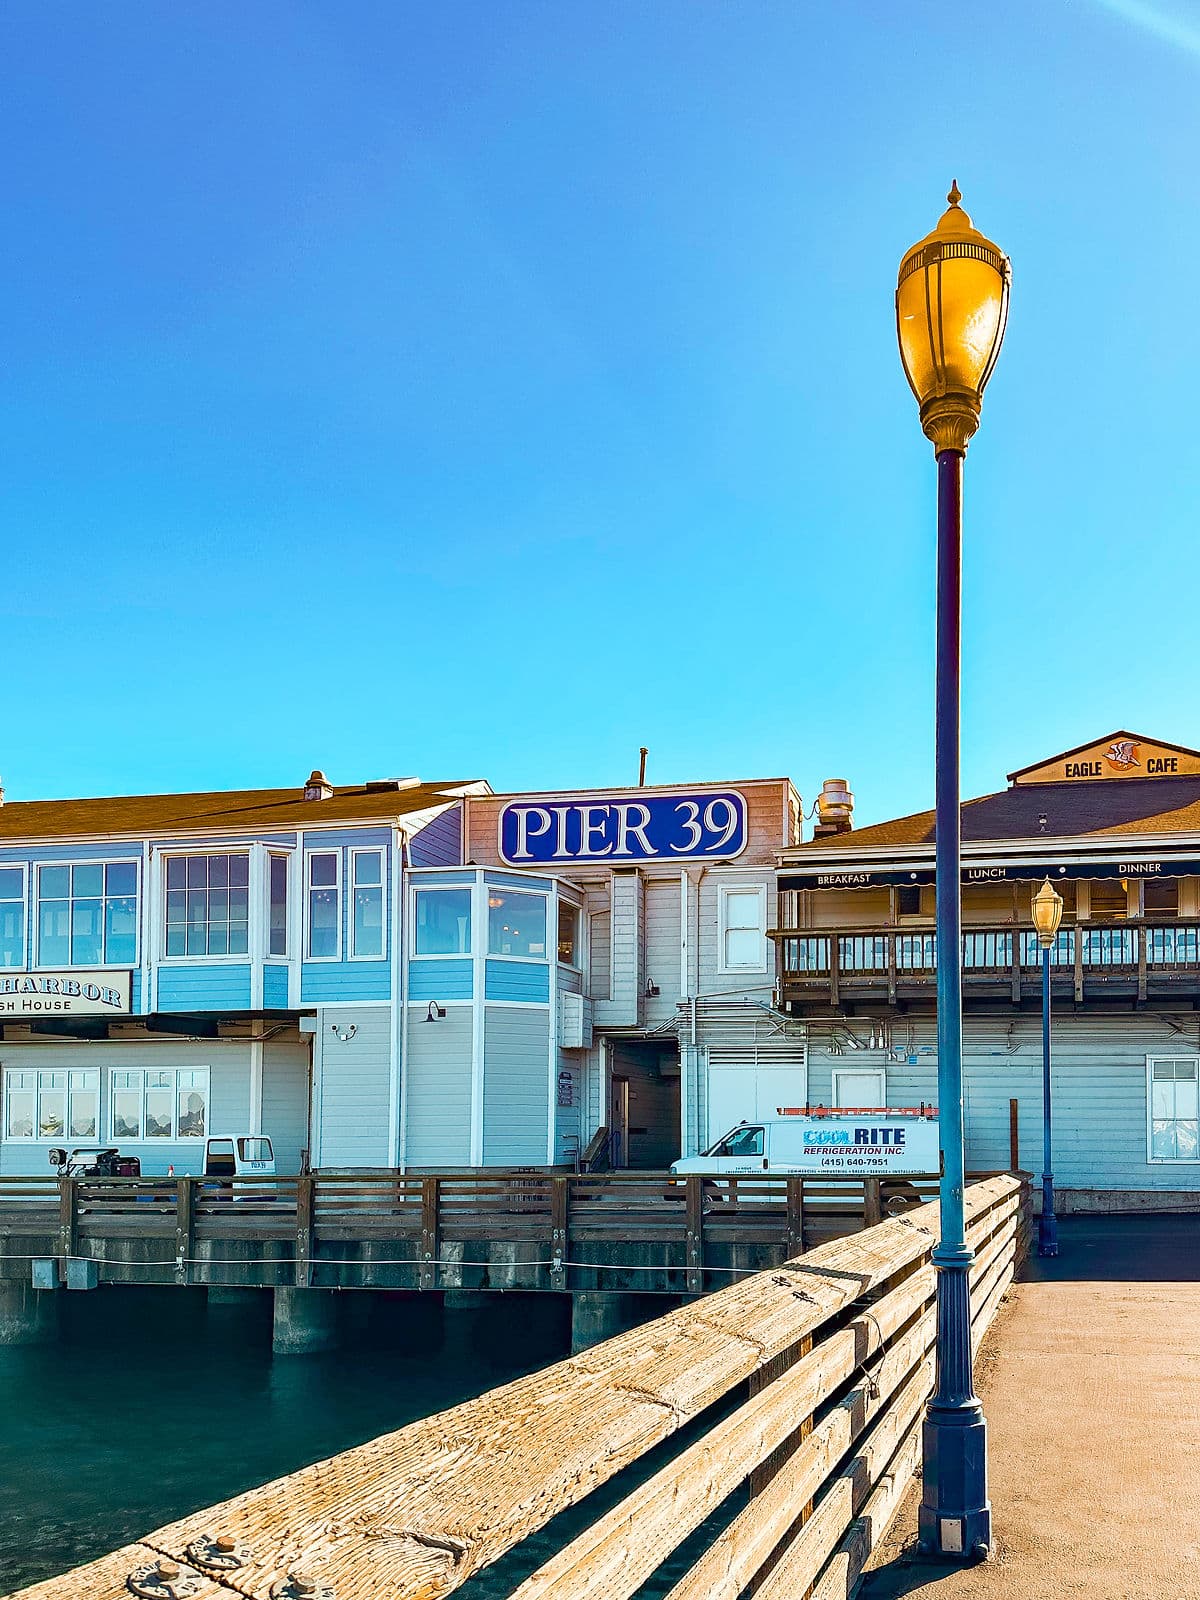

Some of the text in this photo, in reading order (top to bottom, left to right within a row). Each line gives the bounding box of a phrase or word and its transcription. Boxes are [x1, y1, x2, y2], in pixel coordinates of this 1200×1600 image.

[1065, 758, 1178, 778] EAGLE CAFE
[510, 798, 738, 858] PIER 39
[968, 868, 1006, 879] LUNCH
[1118, 863, 1162, 873] DINNER
[817, 873, 872, 885] BREAKFAST
[0, 976, 122, 1009] HARBOR
[854, 1128, 905, 1145] RITE
[803, 1147, 905, 1155] REFRIGERATION INC.
[821, 1158, 888, 1167] (415) 640-7951
